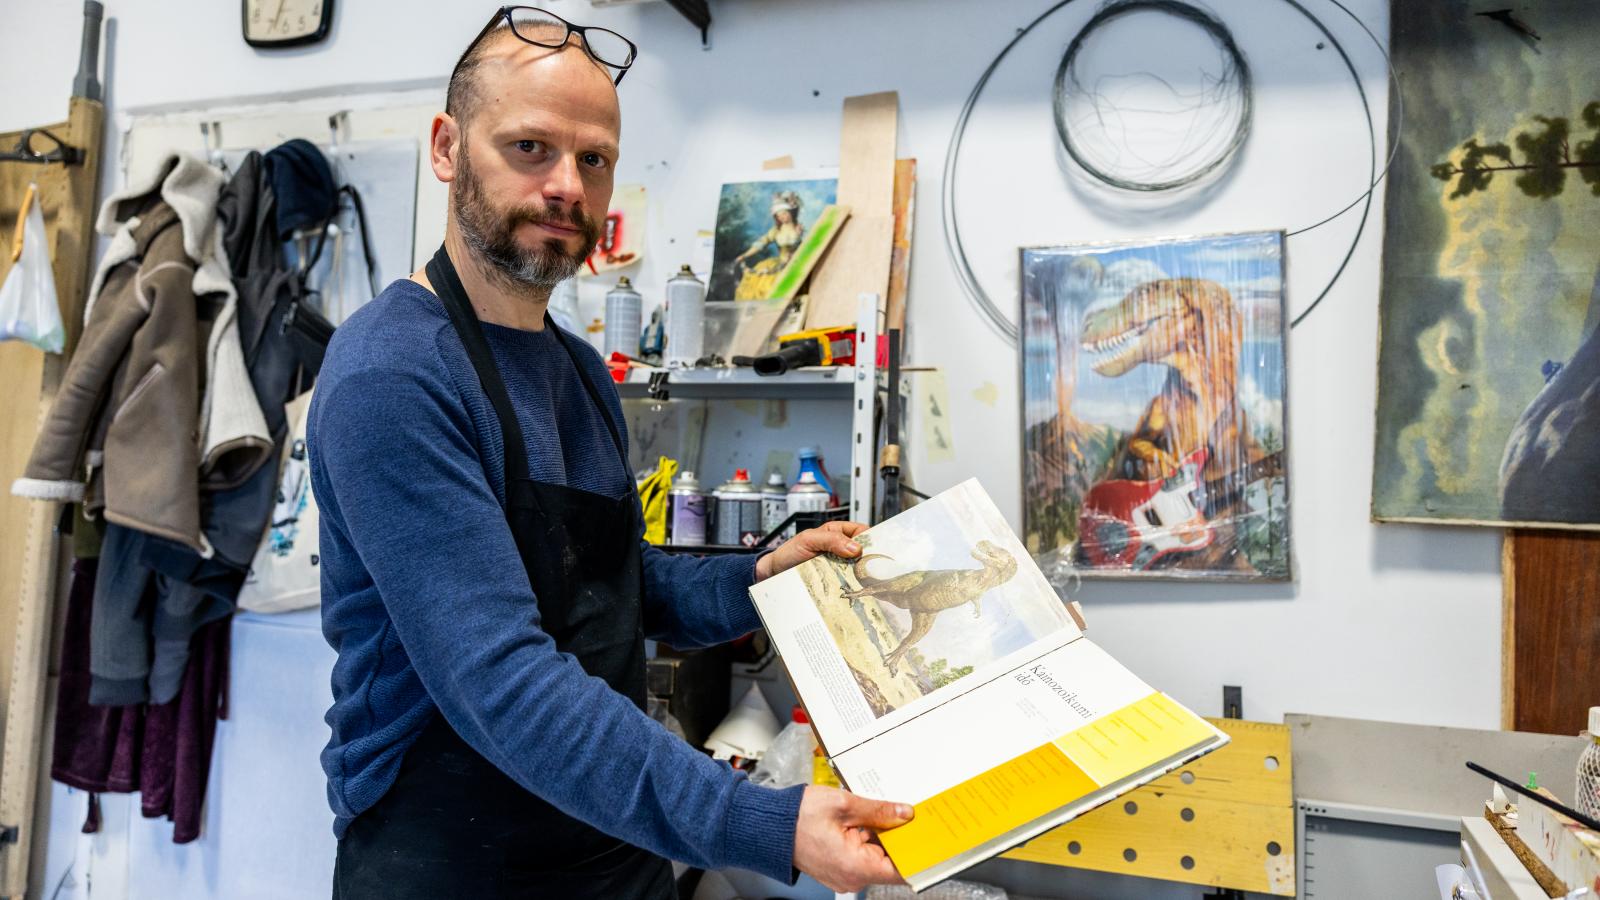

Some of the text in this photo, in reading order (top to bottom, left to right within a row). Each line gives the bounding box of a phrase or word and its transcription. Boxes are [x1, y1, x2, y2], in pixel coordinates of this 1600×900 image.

[282, 18, 290, 34] 6
[298, 15, 306, 31] 5
[1014, 671, 1035, 686] idő
[1029, 664, 1097, 719] Kainozoikumi
